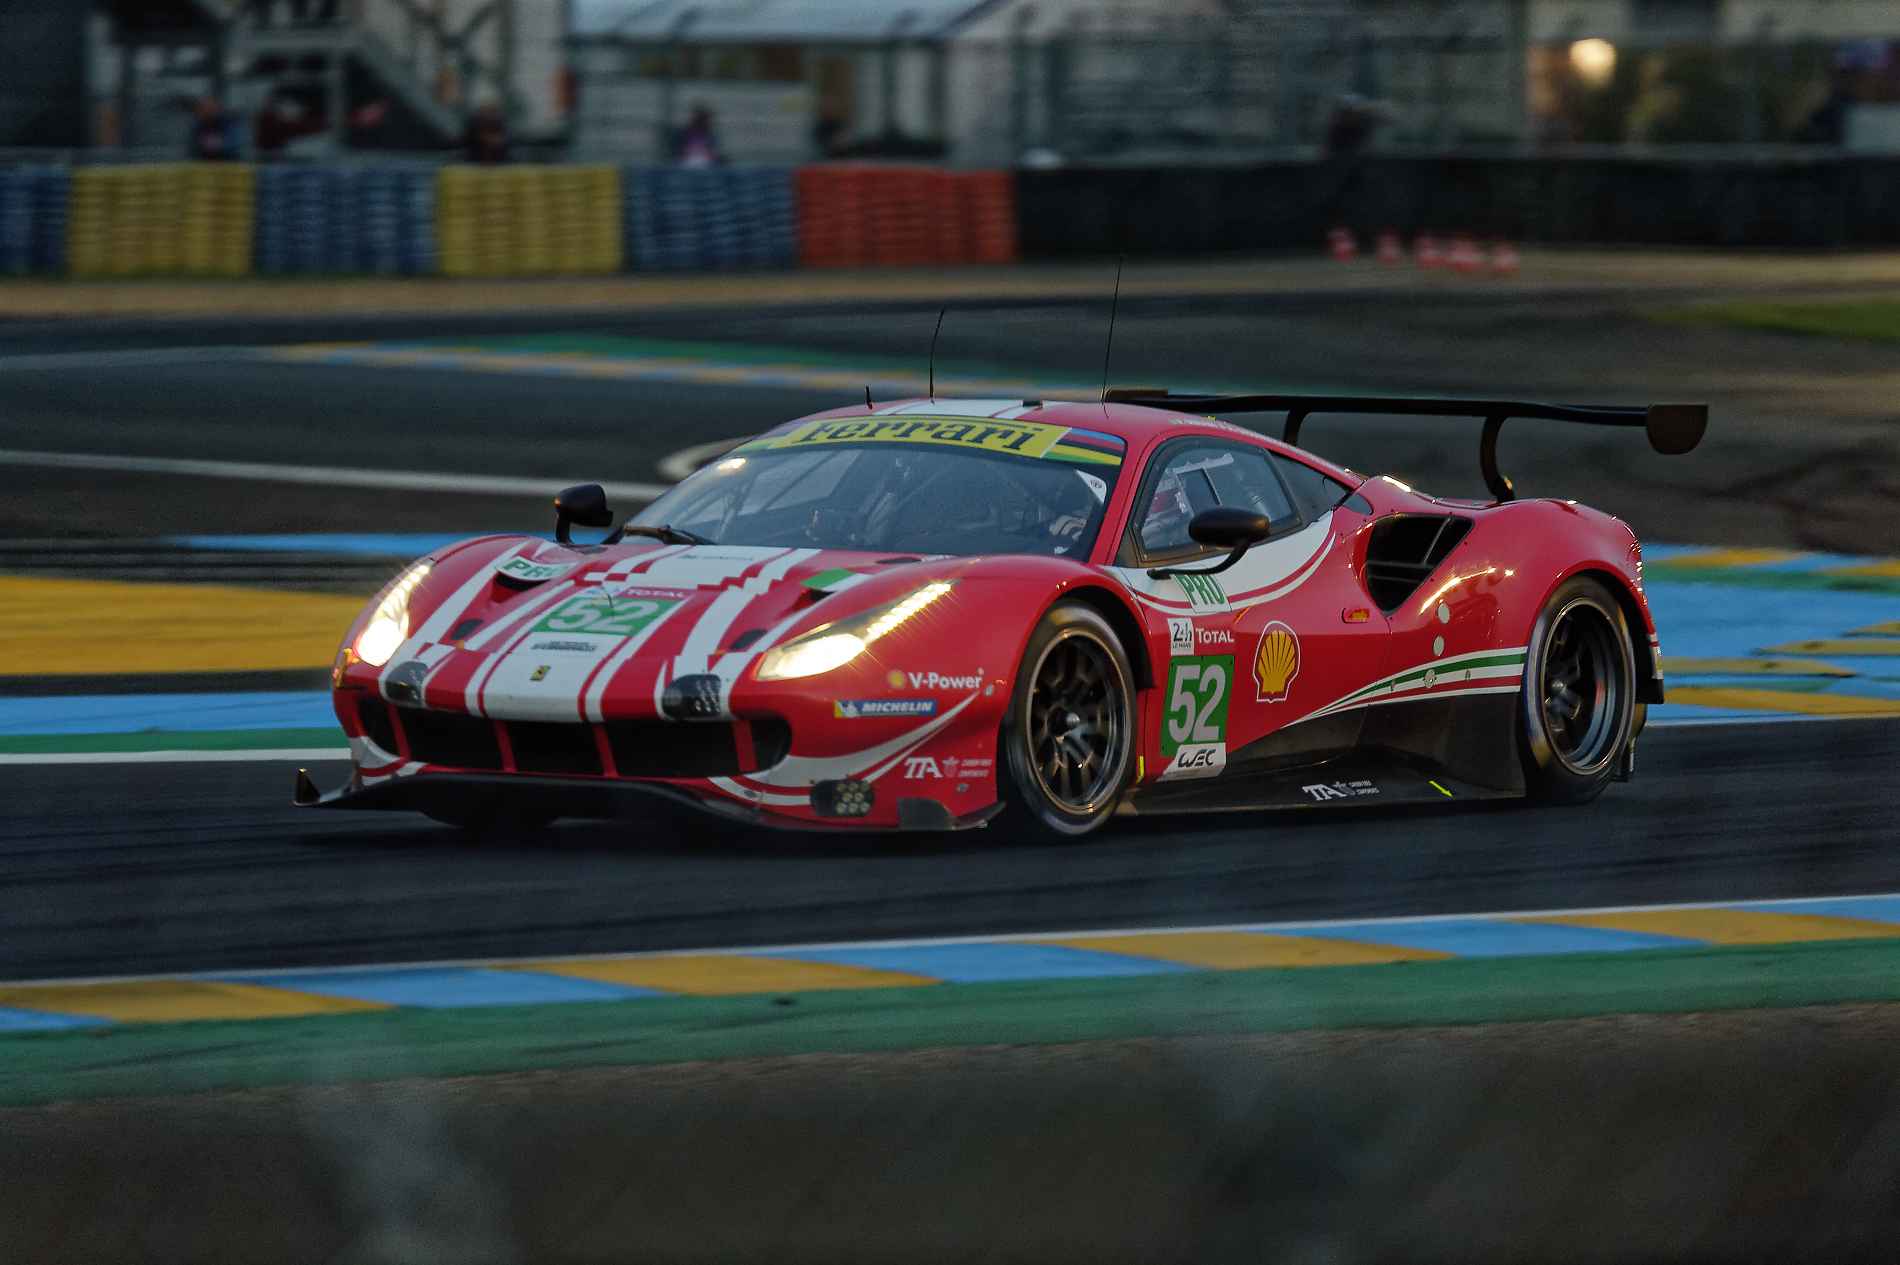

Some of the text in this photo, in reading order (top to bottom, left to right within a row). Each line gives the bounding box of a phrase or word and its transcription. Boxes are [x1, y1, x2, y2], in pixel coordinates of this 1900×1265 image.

[791, 416, 1043, 450] Ferrari
[547, 600, 661, 635] 52
[908, 671, 983, 689] V-Power
[861, 701, 933, 712] MICHELIN
[1167, 663, 1227, 743] 52
[1177, 748, 1217, 768] WEC
